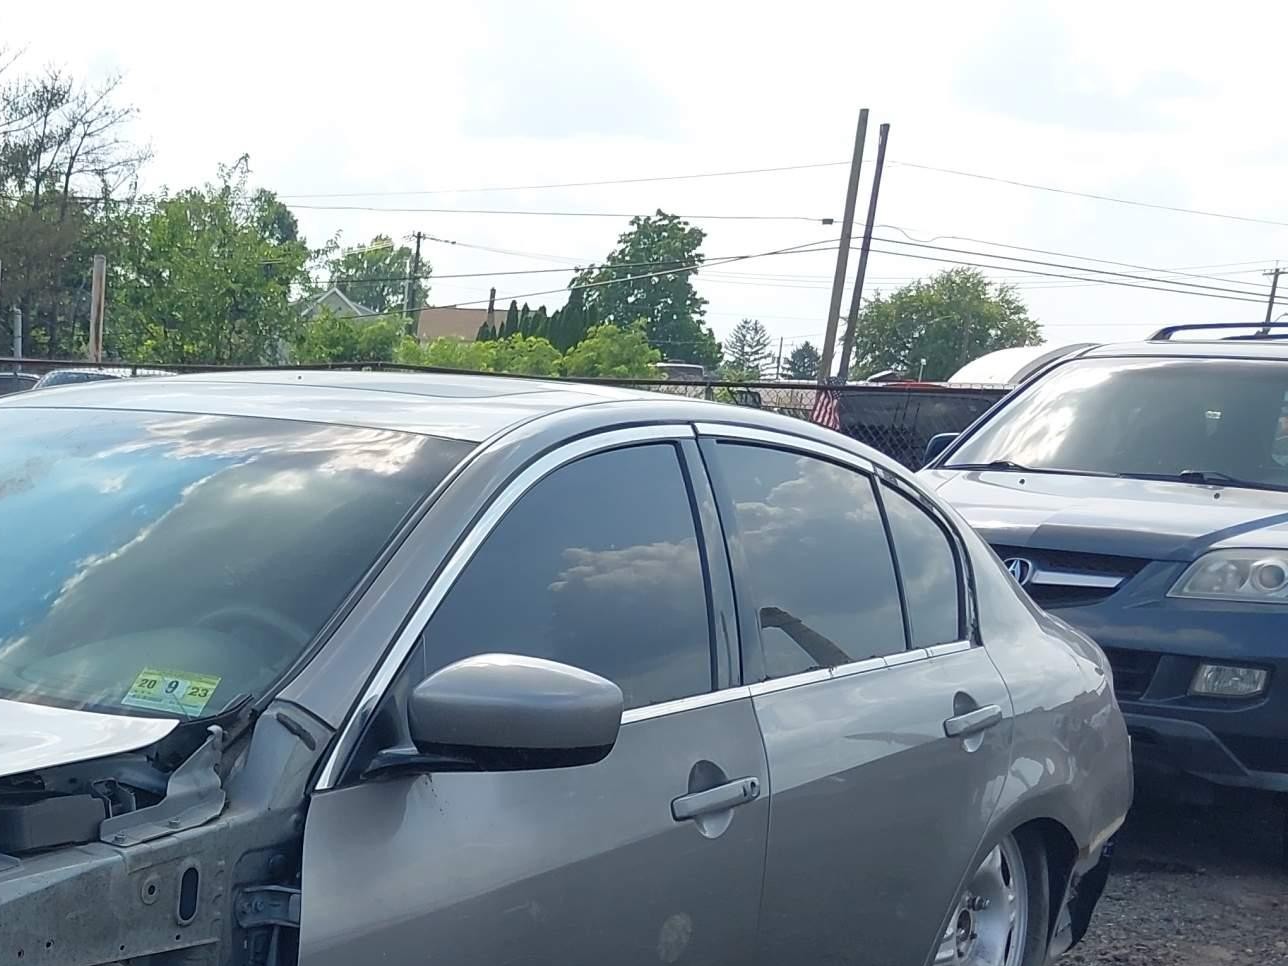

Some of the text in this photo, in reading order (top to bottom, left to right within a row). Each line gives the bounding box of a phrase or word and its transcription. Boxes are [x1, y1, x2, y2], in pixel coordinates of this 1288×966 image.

[138, 678, 209, 698] 20 9 23
